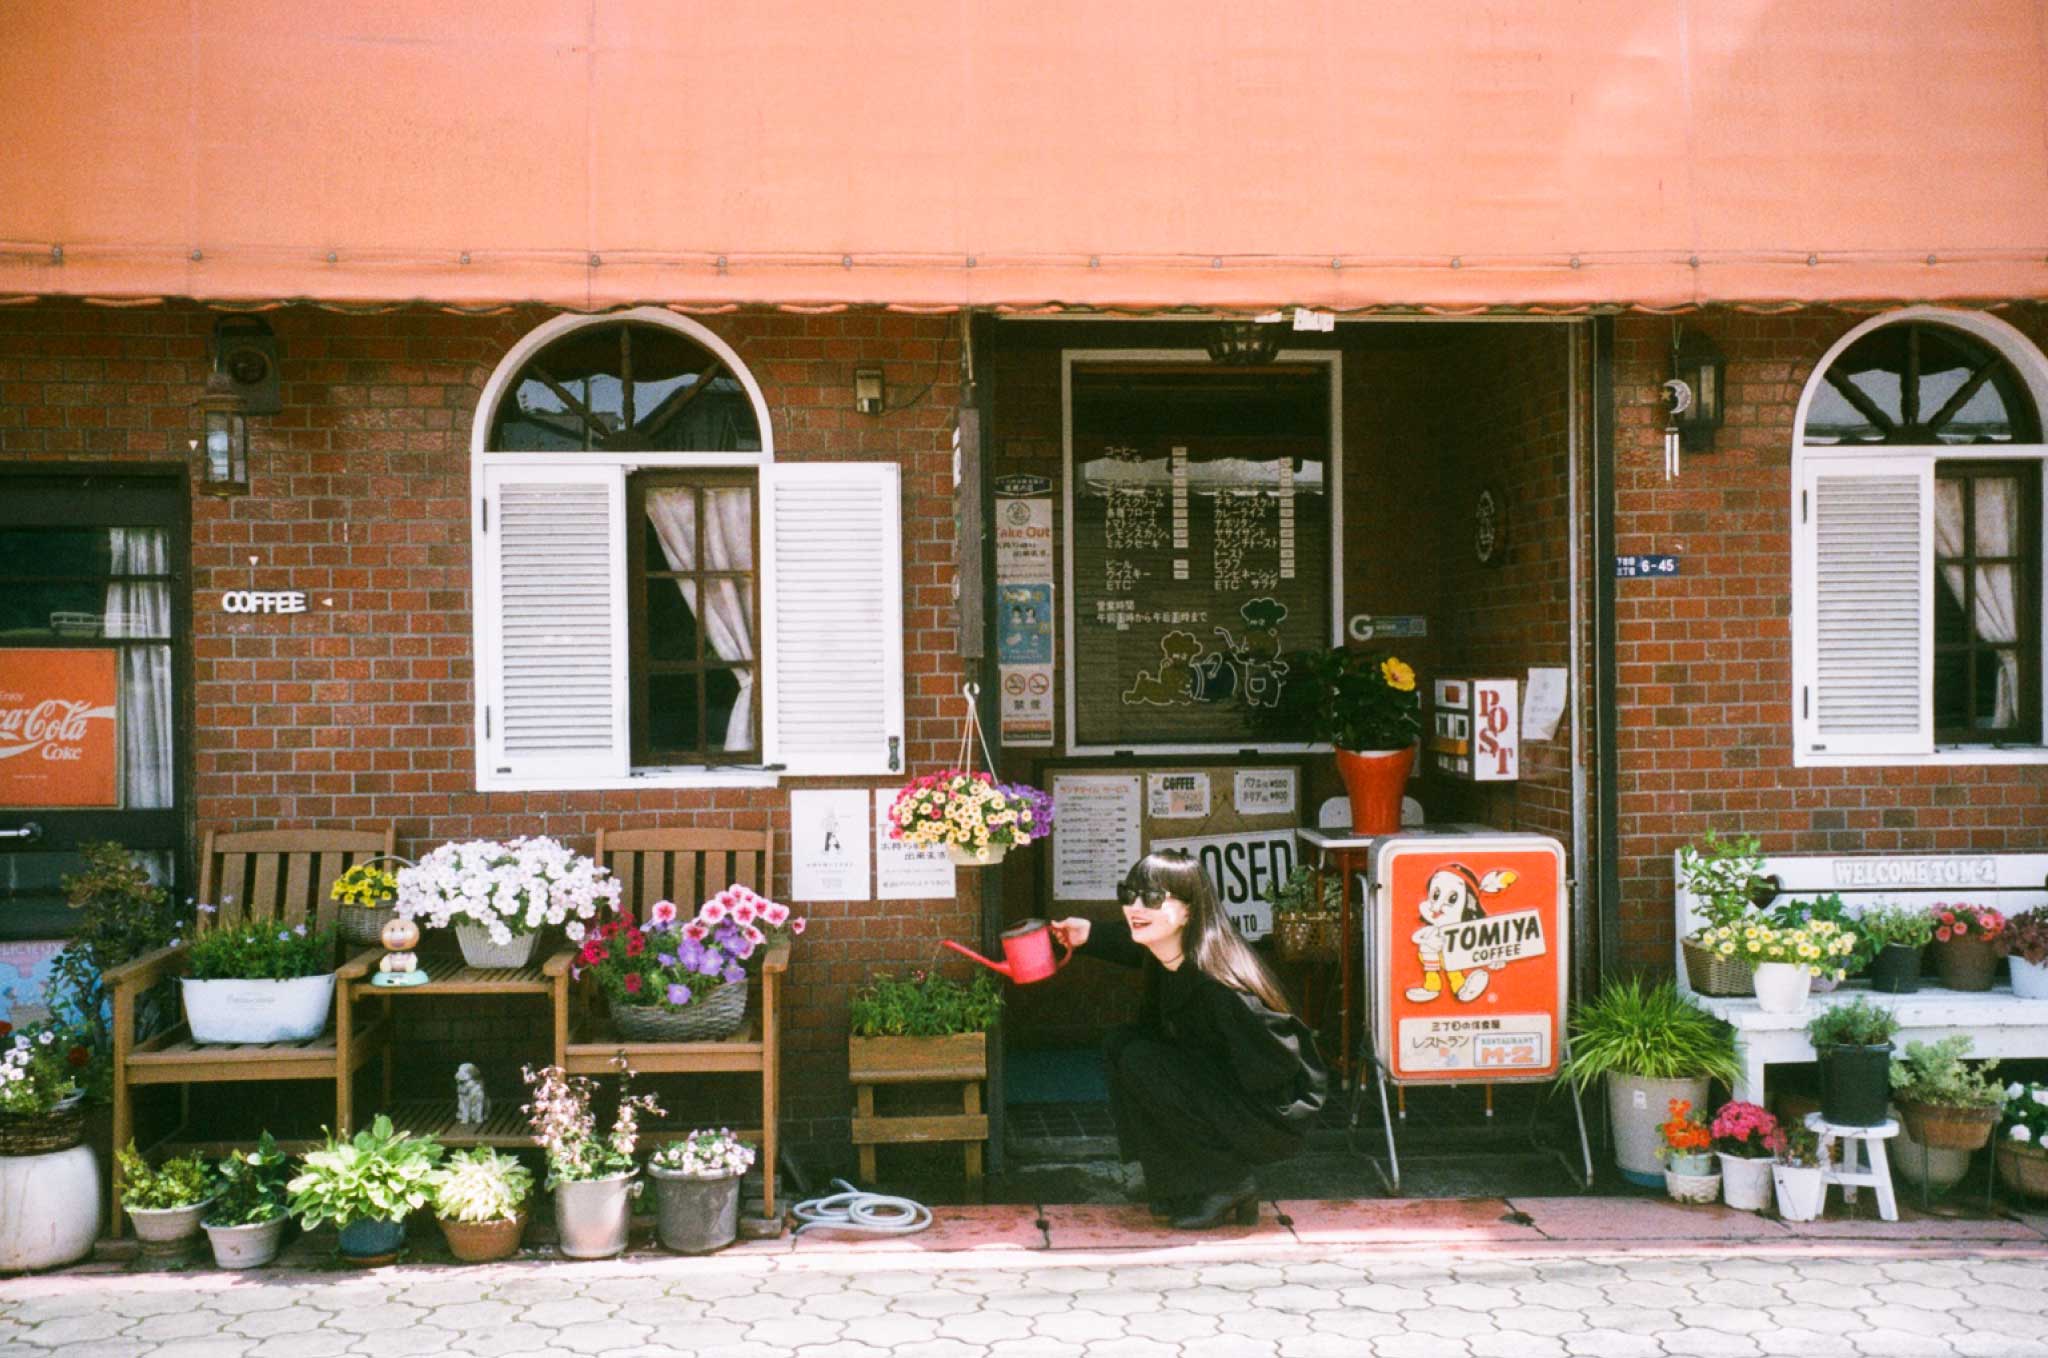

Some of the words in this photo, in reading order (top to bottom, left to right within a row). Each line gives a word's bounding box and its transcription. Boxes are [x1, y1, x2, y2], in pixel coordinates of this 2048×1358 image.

[1105, 497, 1165, 508] アイスクリーム
[1214, 508, 1266, 518] カレーライス
[997, 527, 1025, 538] ake
[1026, 526, 1050, 538] Out
[1106, 539, 1160, 550] ミルクセーキ
[1214, 539, 1277, 549] フレンチトースト
[1214, 549, 1243, 559] トースト
[1106, 560, 1132, 569] ビール
[1641, 559, 1675, 573] 6-45
[222, 590, 307, 614] COFFEE
[1479, 690, 1513, 775] POST
[41, 742, 82, 761] Coke
[1162, 776, 1195, 791] COFFEE
[1182, 839, 1292, 904] OSED
[1834, 861, 1930, 884] WELCOME
[1931, 860, 1958, 883] TO
[1242, 914, 1257, 932] TO
[1444, 916, 1540, 953] TOMIYA
[1472, 943, 1521, 962] COFFEE
[1412, 1035, 1470, 1049] レストラン
[1481, 1045, 1535, 1065] M-2
